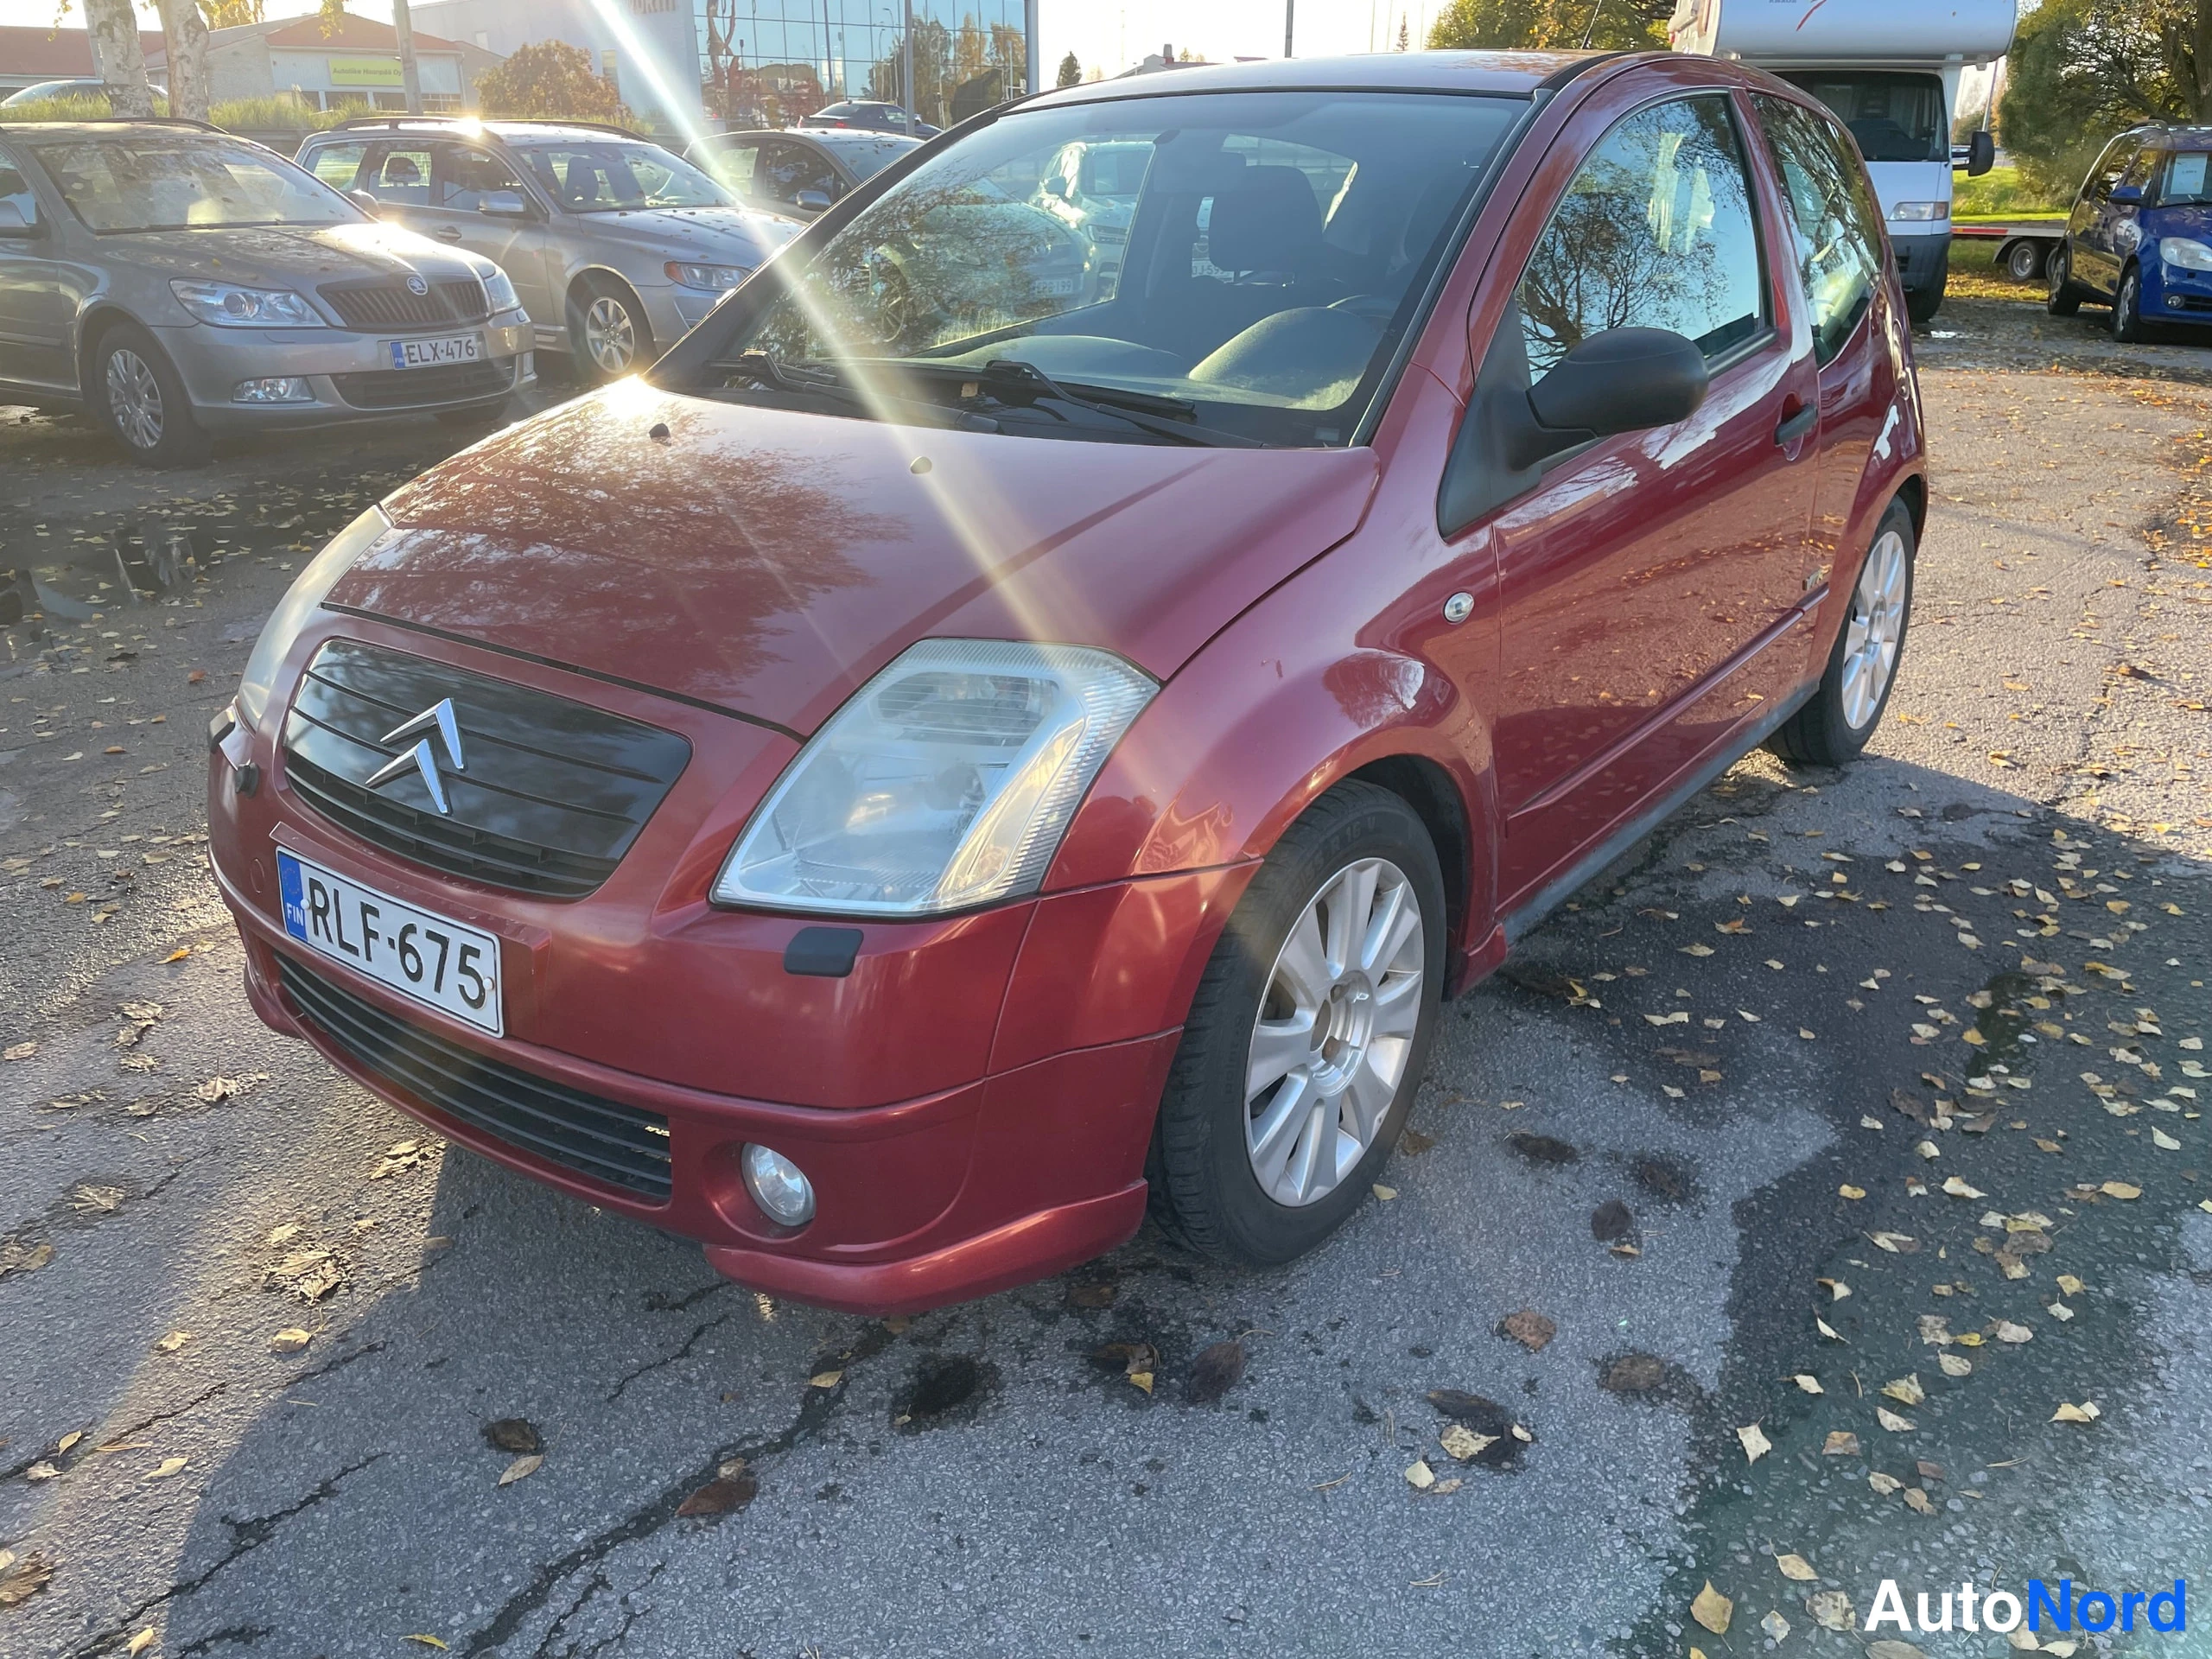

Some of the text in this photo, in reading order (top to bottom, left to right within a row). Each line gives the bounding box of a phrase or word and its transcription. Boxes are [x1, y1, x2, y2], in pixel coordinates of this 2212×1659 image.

[405, 339, 475, 364] ELX-476
[286, 903, 304, 926] FIN
[308, 877, 486, 1010] RLF-675
